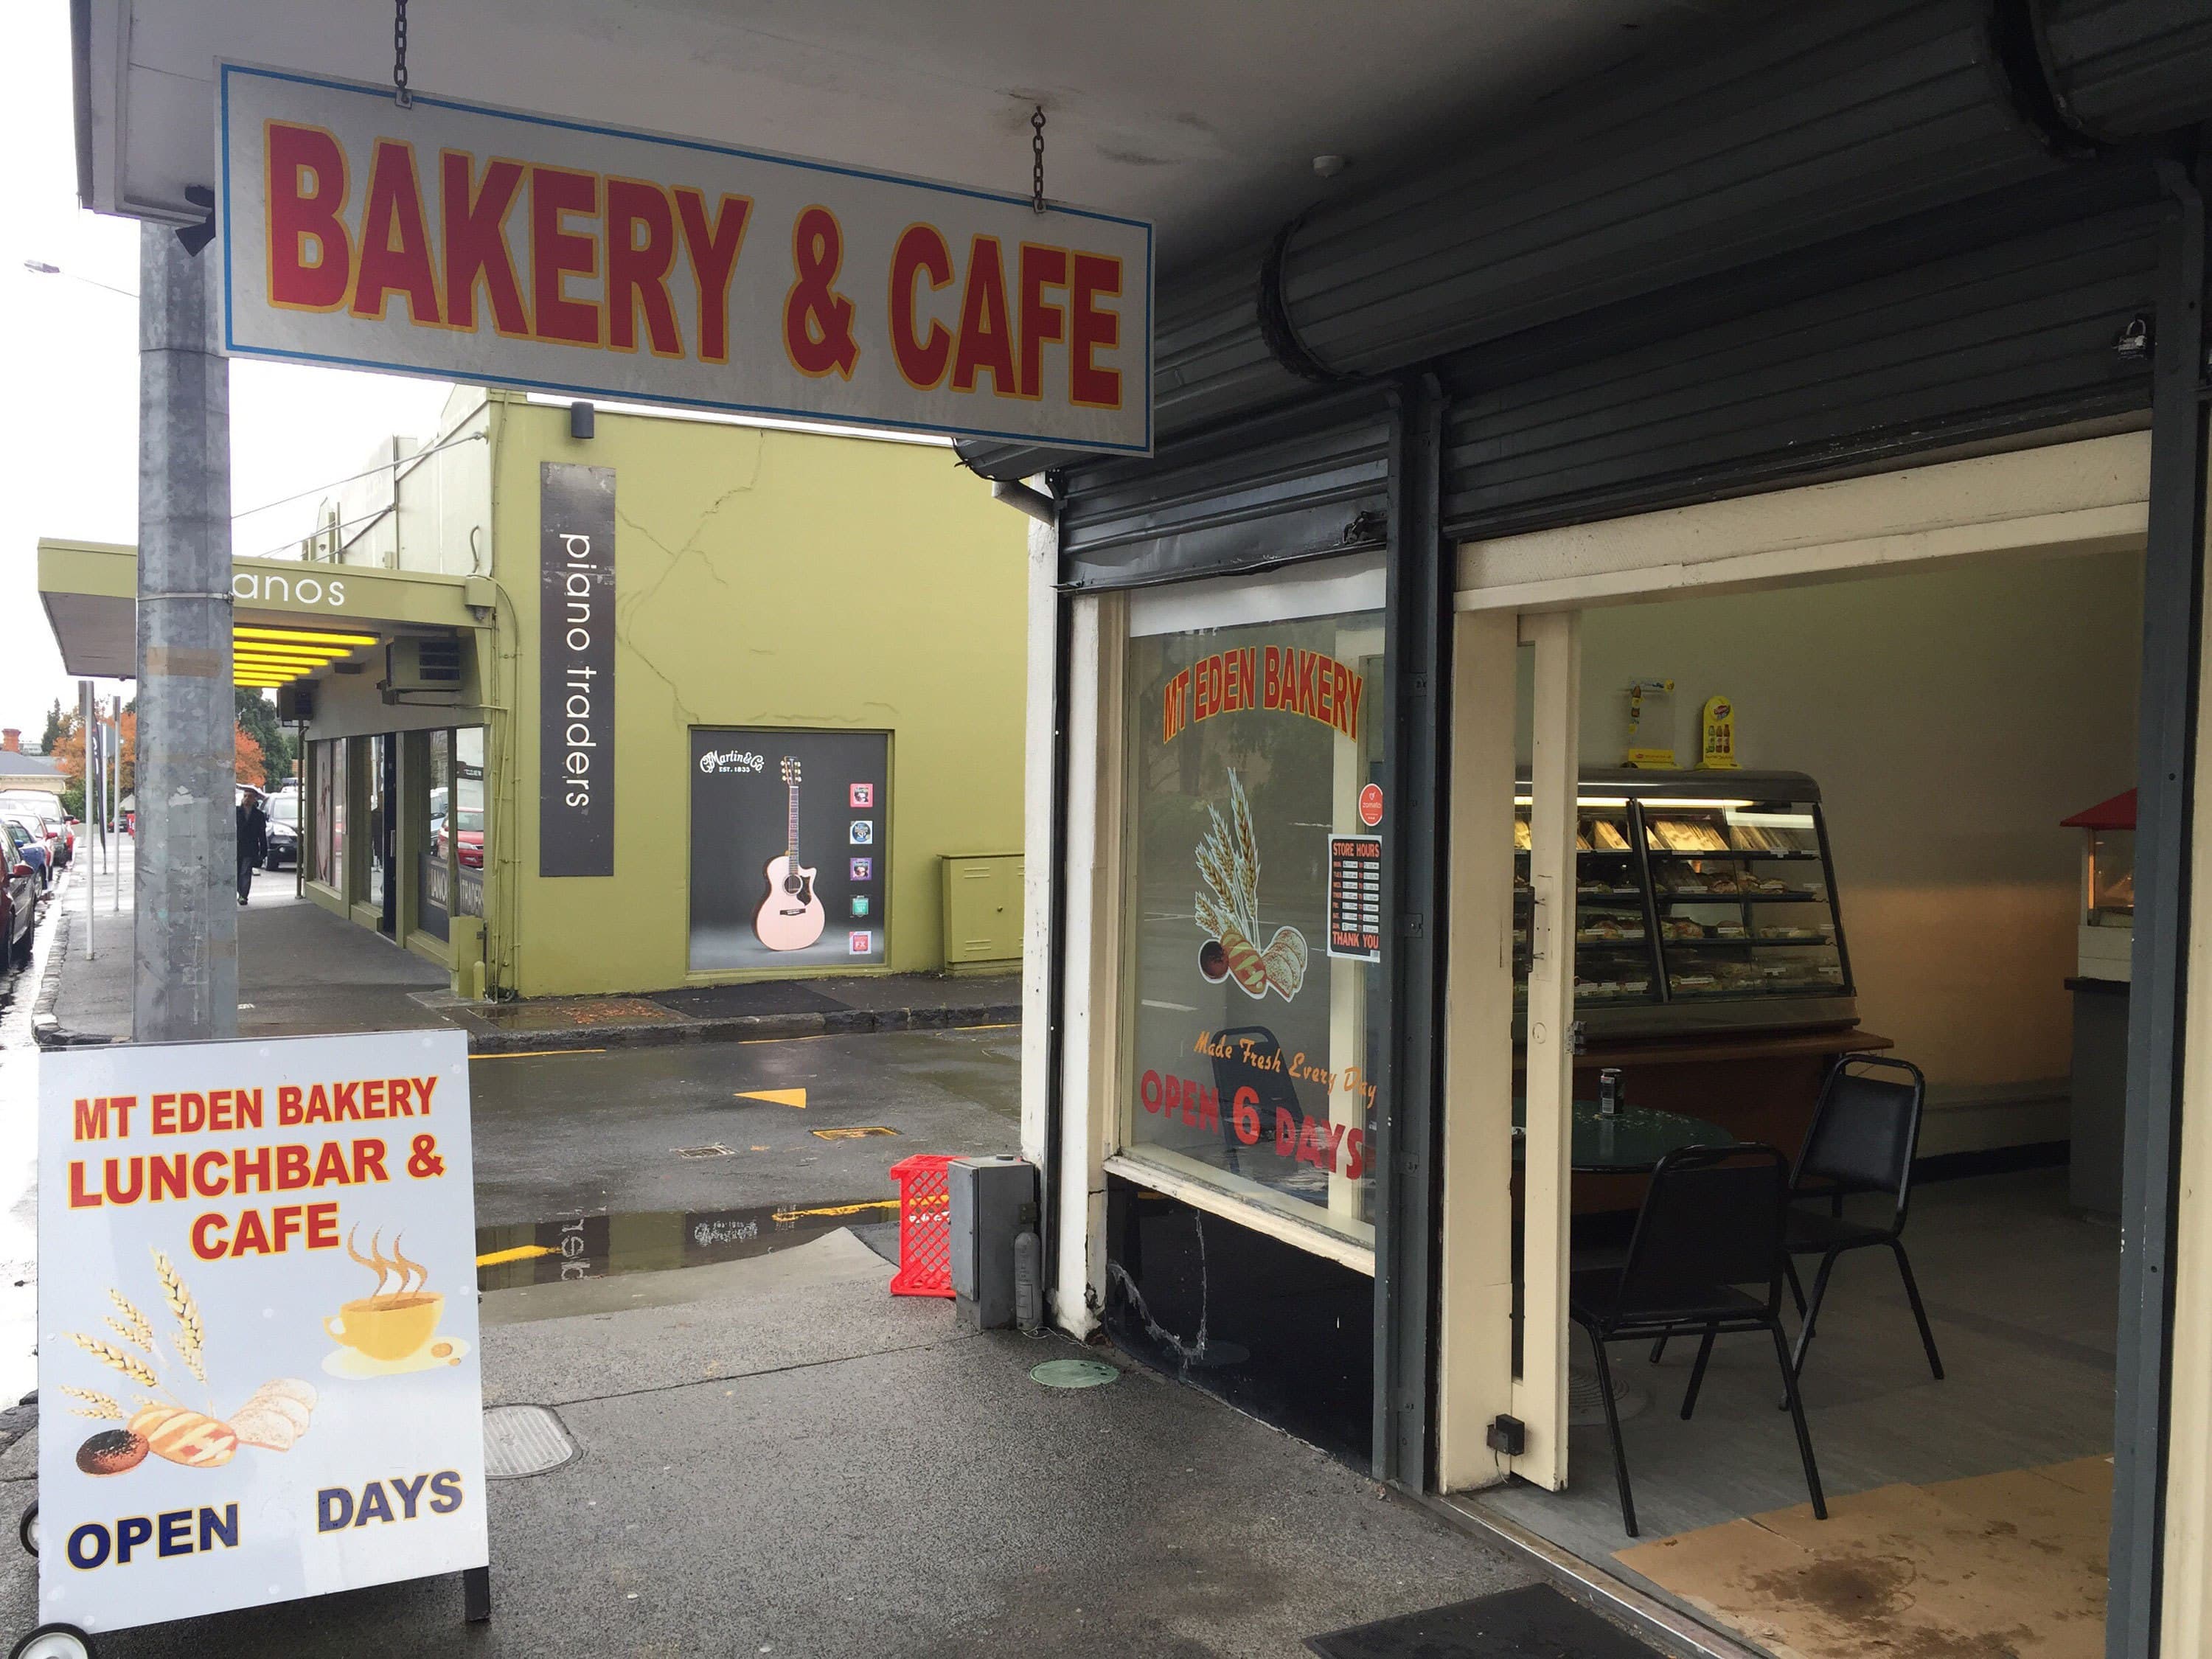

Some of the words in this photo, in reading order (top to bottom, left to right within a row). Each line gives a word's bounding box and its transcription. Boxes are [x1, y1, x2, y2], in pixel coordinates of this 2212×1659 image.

[263, 117, 754, 365] BAKERY
[782, 204, 860, 382] &
[888, 221, 1123, 411] CAFE
[232, 573, 345, 606] anos
[559, 533, 597, 652] piano
[1164, 666, 1191, 745] MT
[1194, 647, 1256, 723] EDEN
[1262, 645, 1363, 742] BAKERY
[564, 665, 597, 807] traders
[1333, 842, 1354, 856] STORE
[1356, 843, 1380, 858] HOURS
[1332, 931, 1360, 947] THANK
[1363, 934, 1380, 950] YOU
[73, 1096, 138, 1142] MT
[149, 1086, 265, 1136] EDEN
[276, 1074, 439, 1128] BAKERY
[1193, 1030, 1233, 1059] Made
[1239, 1037, 1281, 1073] Fresh
[1288, 1052, 1337, 1095] Every
[1343, 1066, 1377, 1109] Day
[1141, 1069, 1220, 1135] OPEN
[1232, 1086, 1261, 1145] 6
[1275, 1107, 1364, 1180] DAYS
[67, 1137, 389, 1210] LUNCHBAR
[406, 1133, 448, 1181] &
[189, 1201, 341, 1263] CAFE
[65, 1500, 241, 1572] OPEN
[315, 1468, 466, 1535] DAYS
